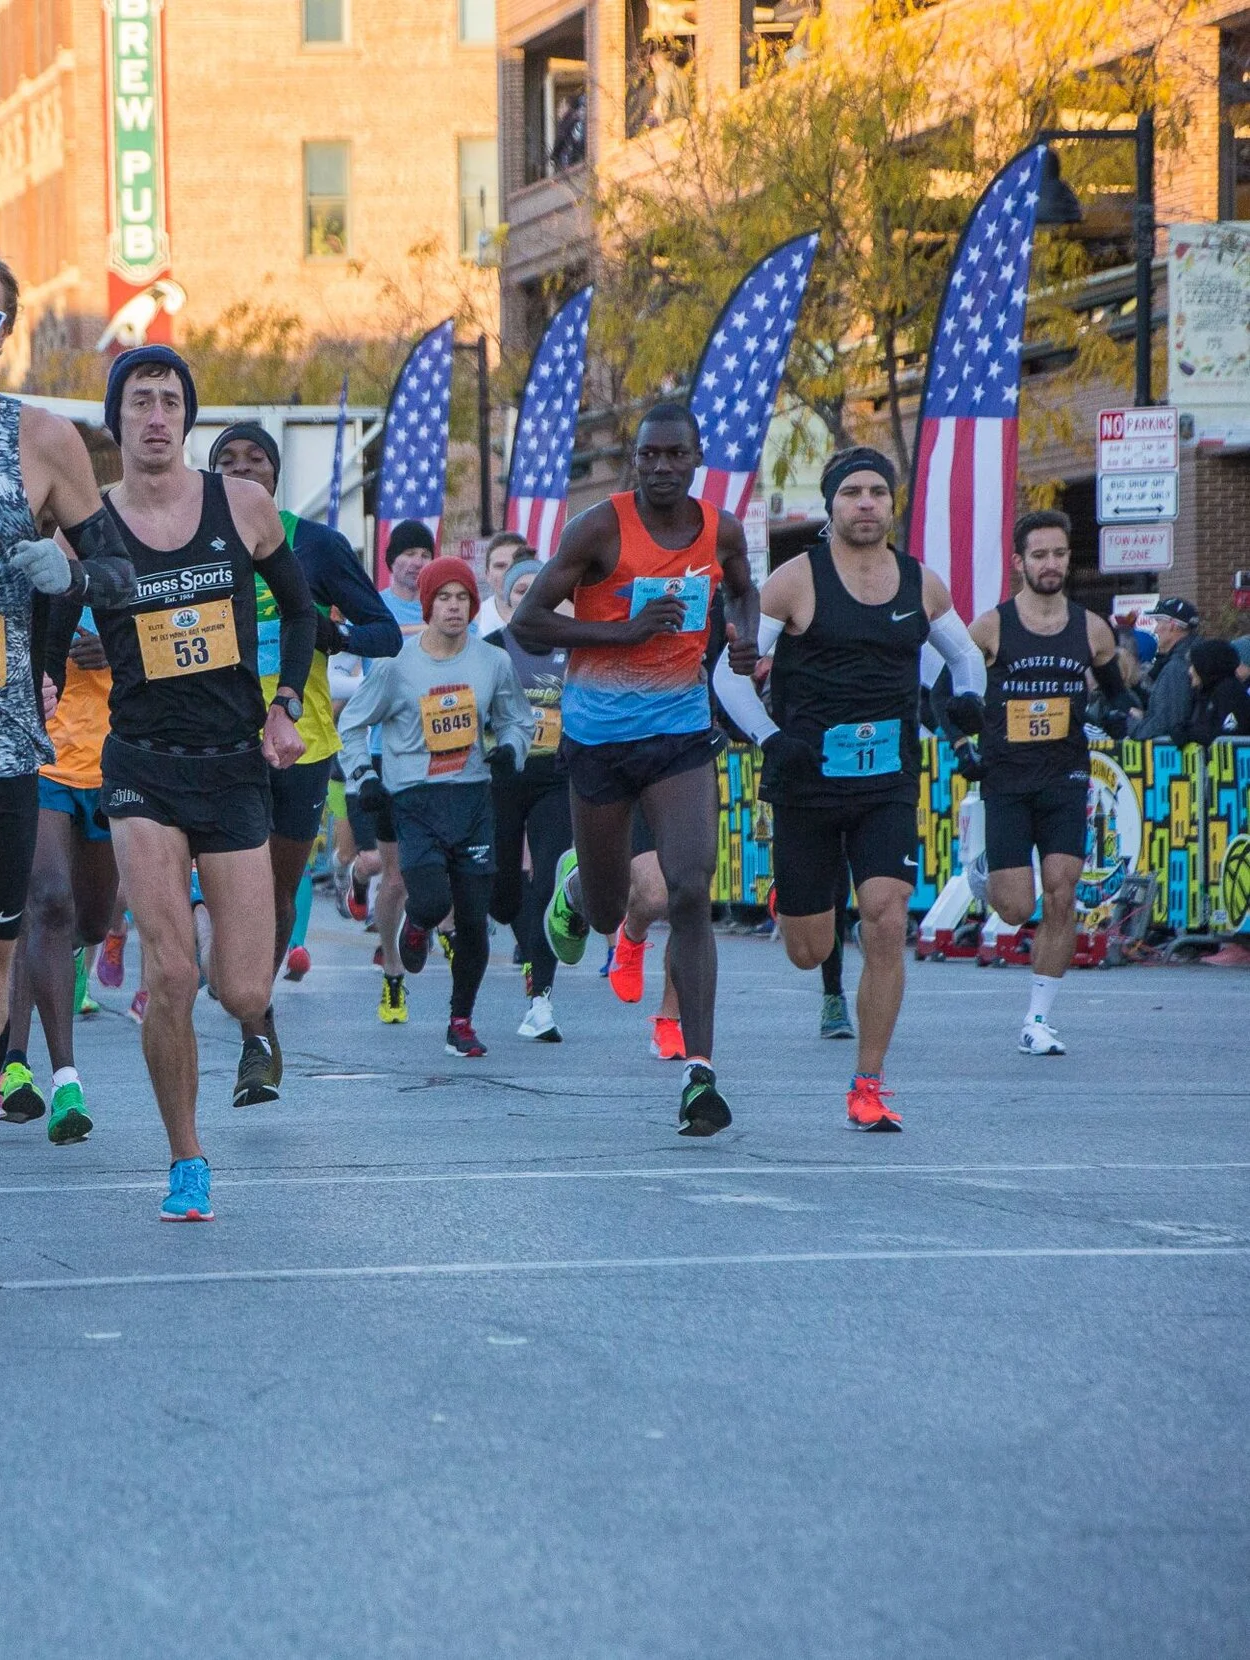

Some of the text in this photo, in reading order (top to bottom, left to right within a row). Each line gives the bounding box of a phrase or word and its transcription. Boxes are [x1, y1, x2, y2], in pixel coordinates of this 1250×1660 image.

[122, 150, 155, 259] PUB
[1102, 414, 1173, 439] NO PARKING
[1111, 479, 1125, 490] BUS
[1129, 479, 1148, 489] DROP
[1121, 550, 1151, 562] ZONE
[136, 568, 233, 598] tness Sports
[164, 593, 177, 604] Est.
[174, 637, 209, 668] 53
[1007, 656, 1054, 674] JACUZZI
[1002, 681, 1059, 693] ATHLETIC
[432, 713, 472, 735] 6845
[1030, 720, 1050, 736] 55
[856, 748, 875, 770] 11
